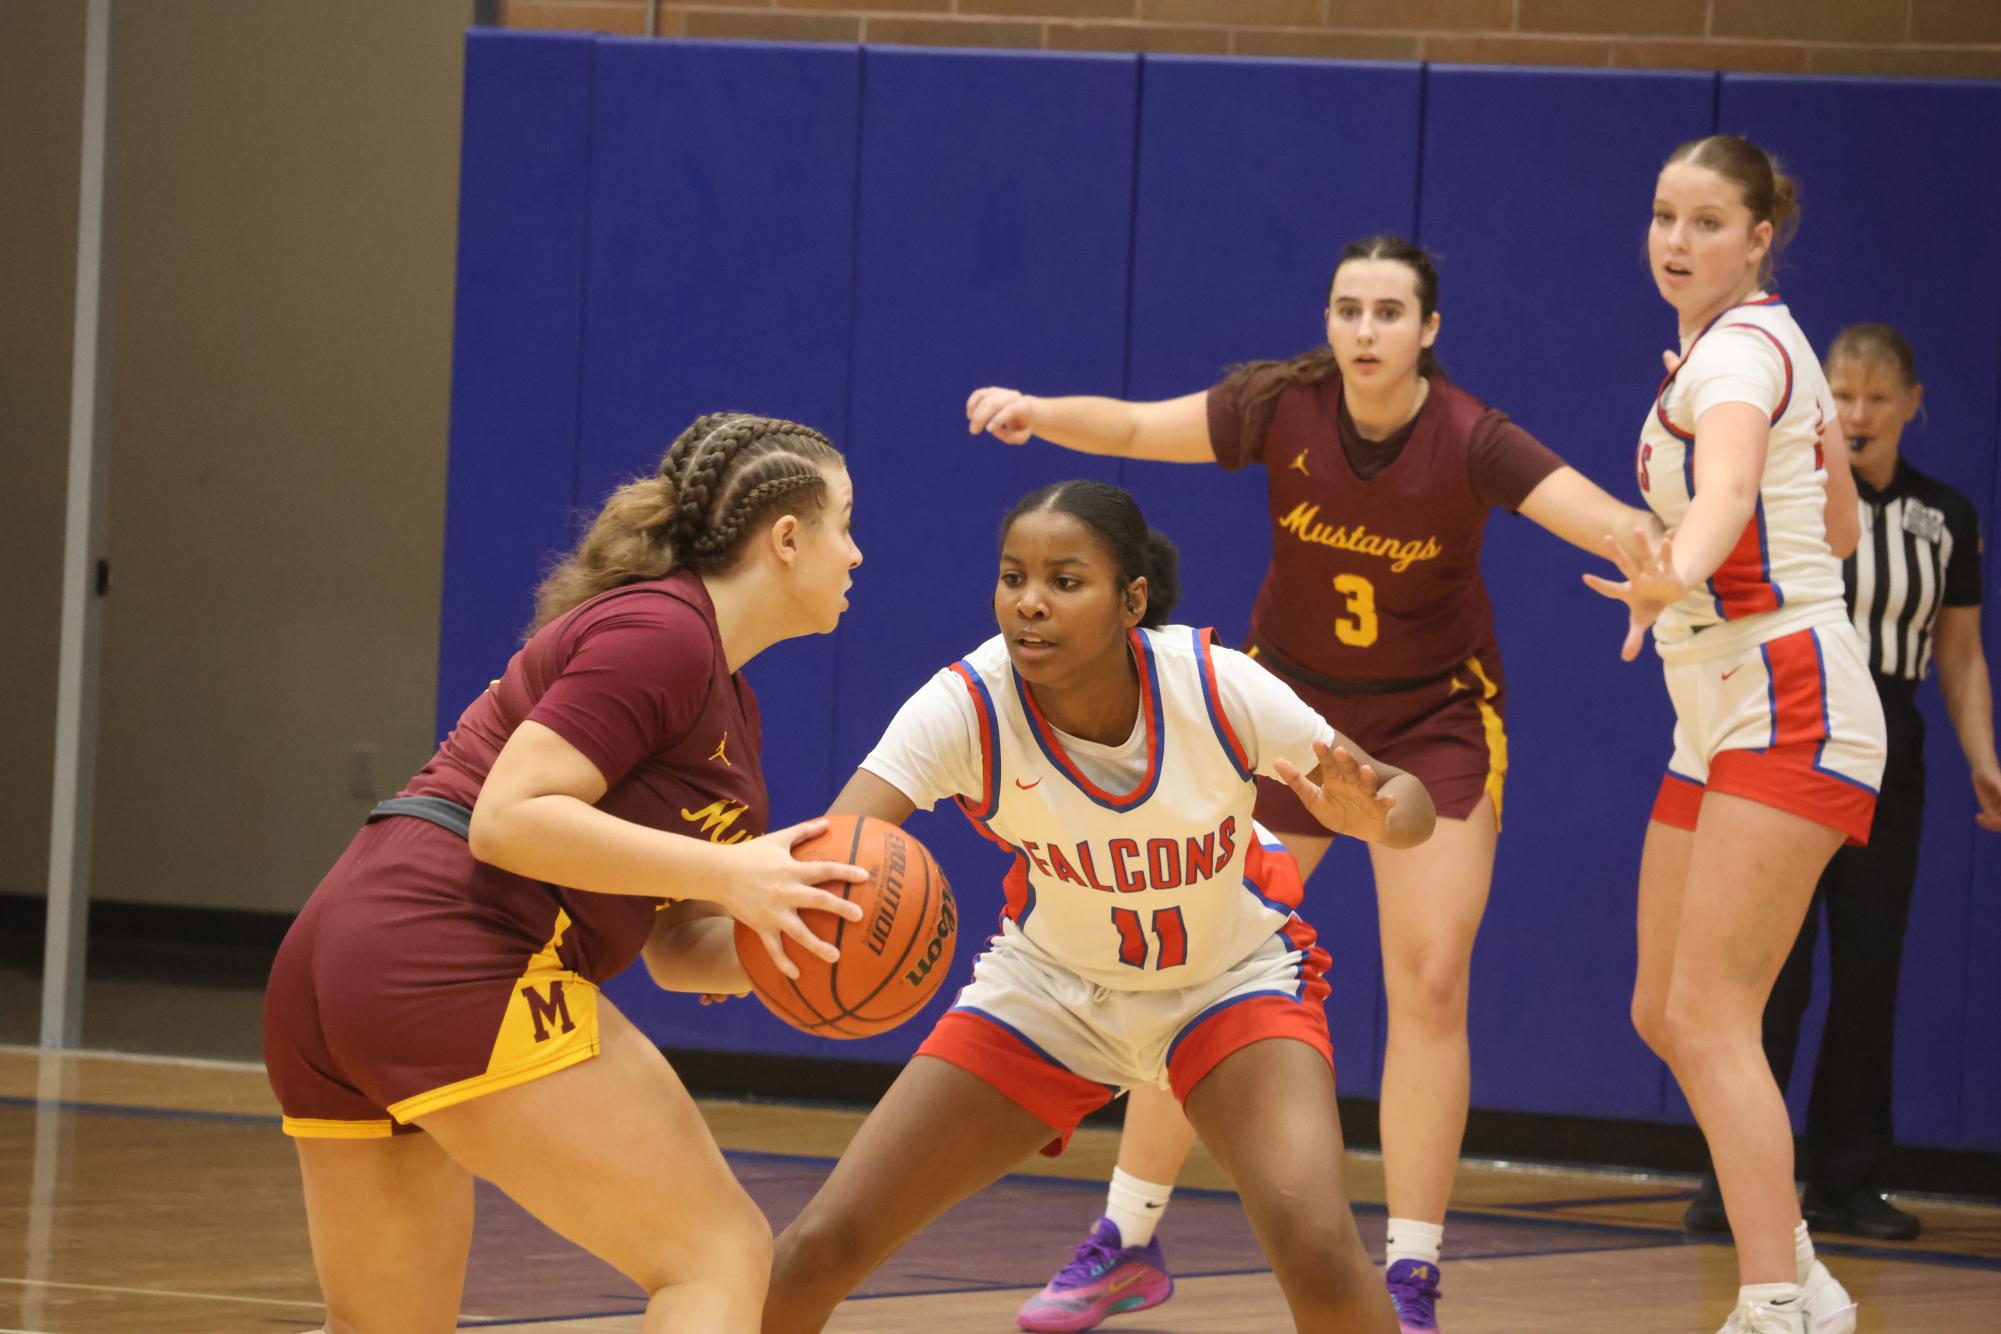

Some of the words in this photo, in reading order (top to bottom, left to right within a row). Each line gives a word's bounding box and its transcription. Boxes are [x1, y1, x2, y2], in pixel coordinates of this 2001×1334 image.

[1279, 501, 1442, 573] Mustangs
[1333, 573, 1378, 648] 3
[1021, 815, 1236, 894] FALCONS
[1111, 905, 1188, 971] 11
[521, 980, 576, 1043] M
